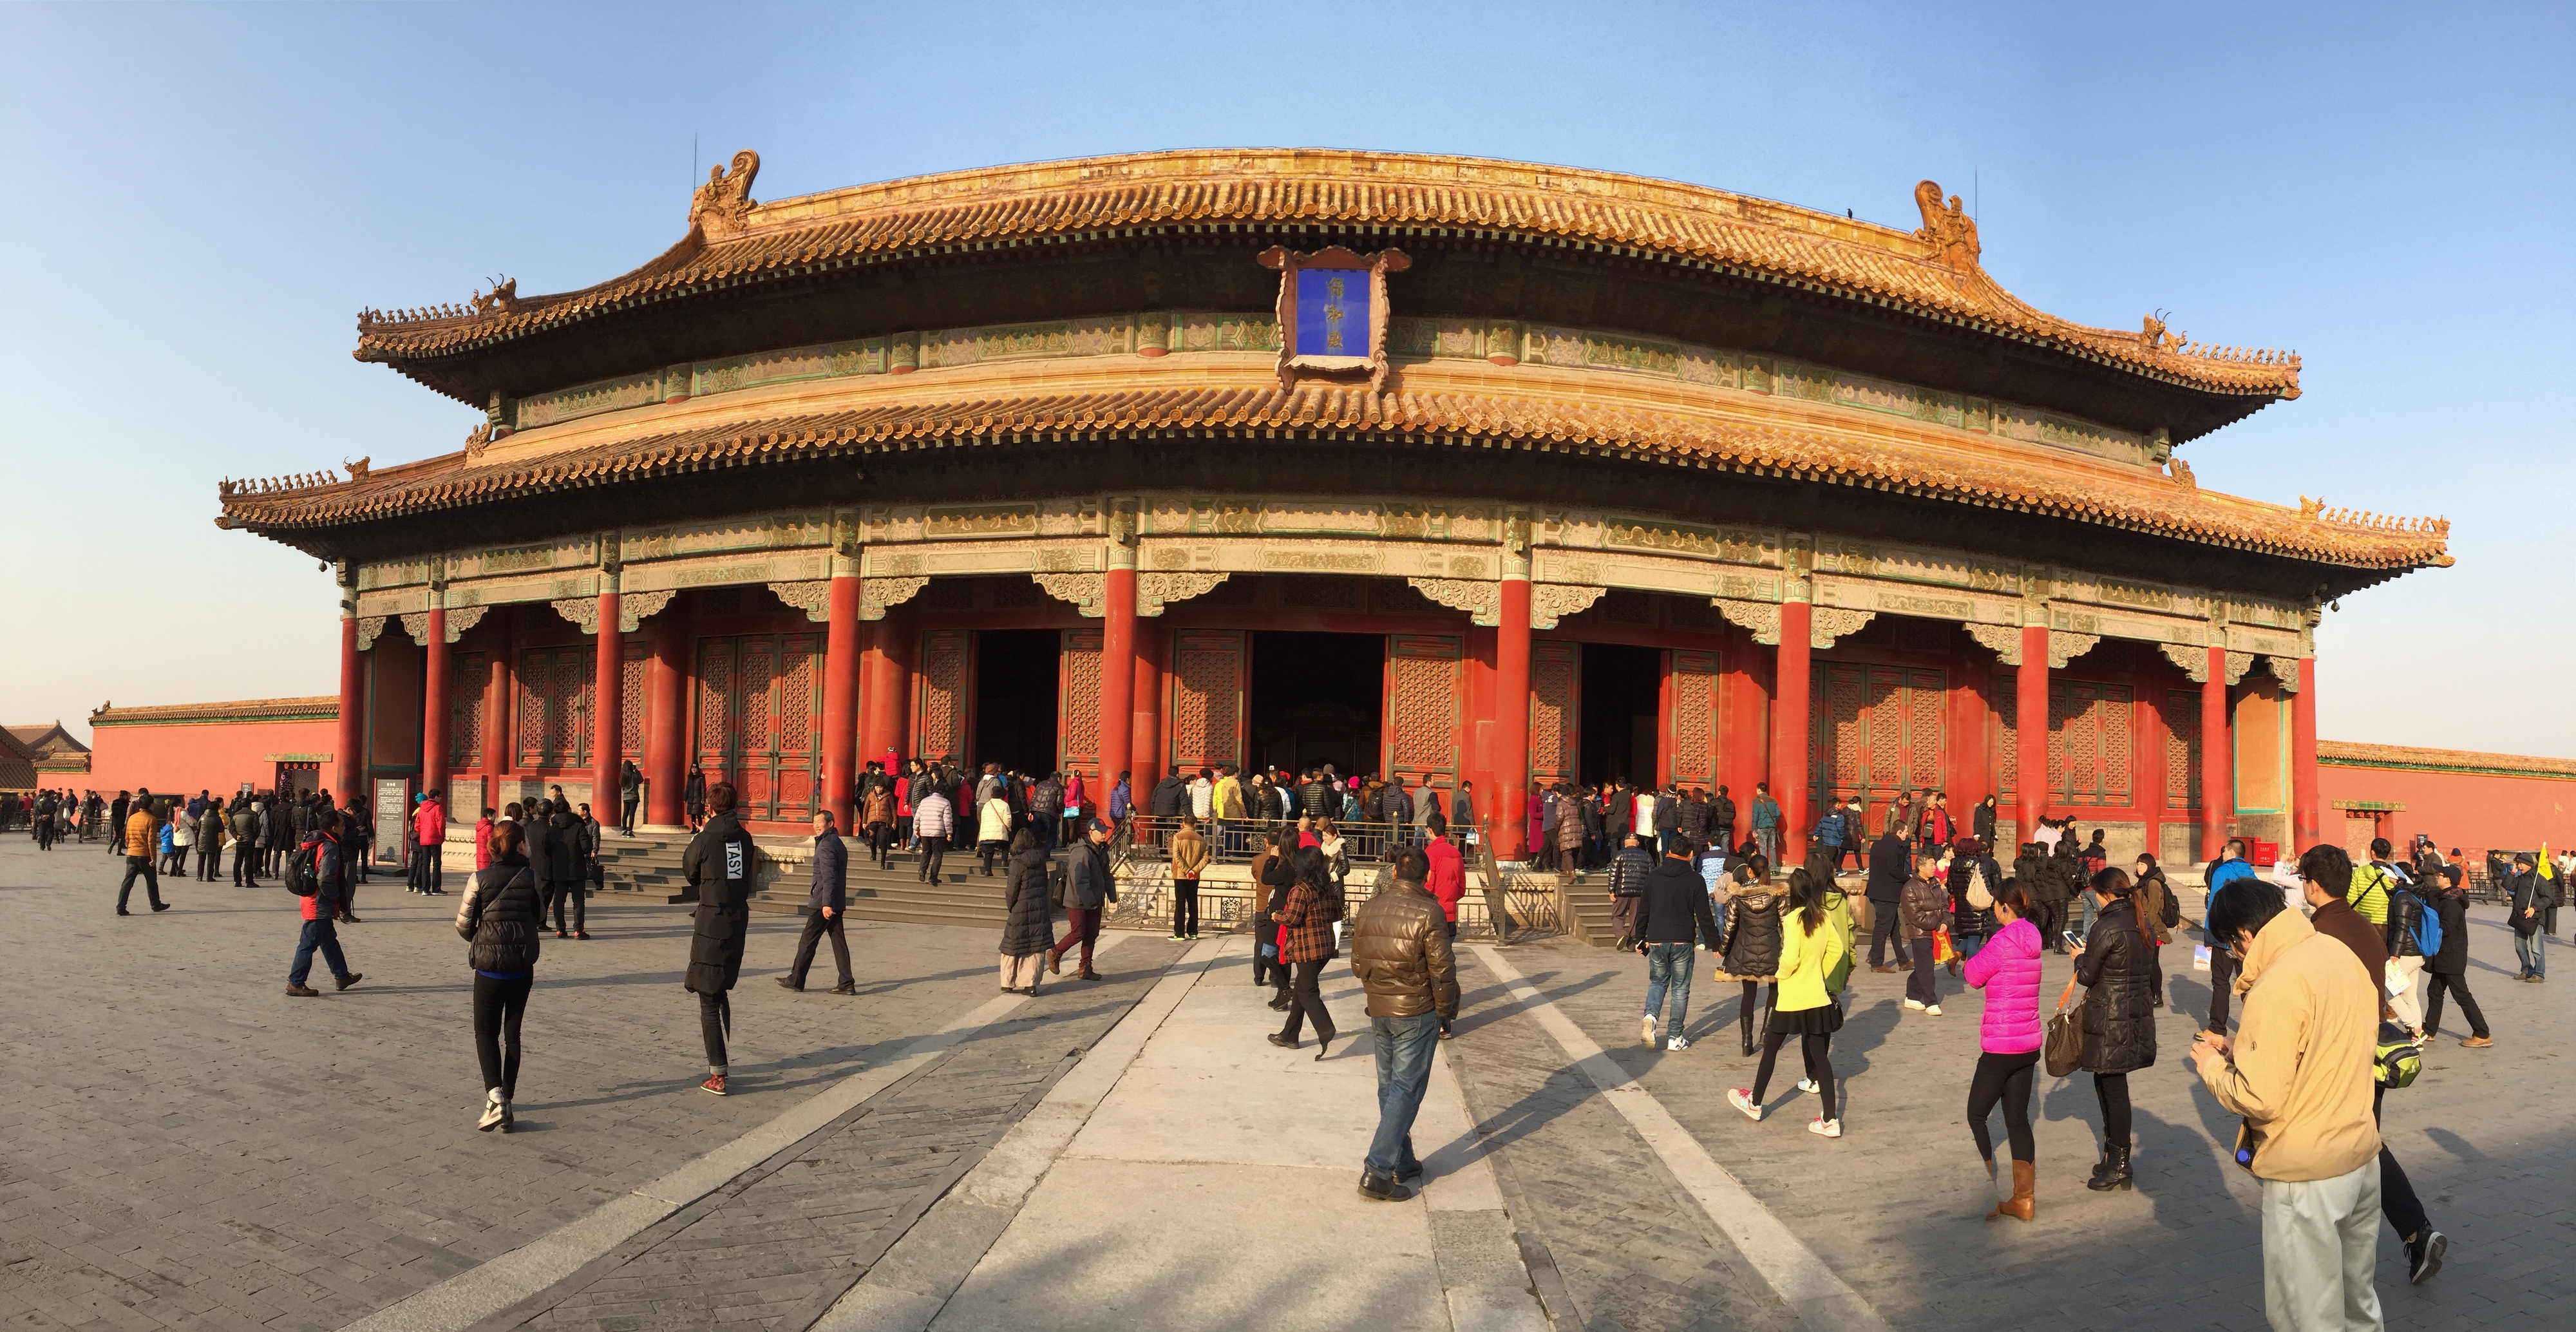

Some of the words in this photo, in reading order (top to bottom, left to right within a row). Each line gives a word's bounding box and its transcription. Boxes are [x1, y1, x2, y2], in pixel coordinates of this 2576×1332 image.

[1327, 278, 1344, 348] 保和殿
[728, 844, 741, 876] TASY
